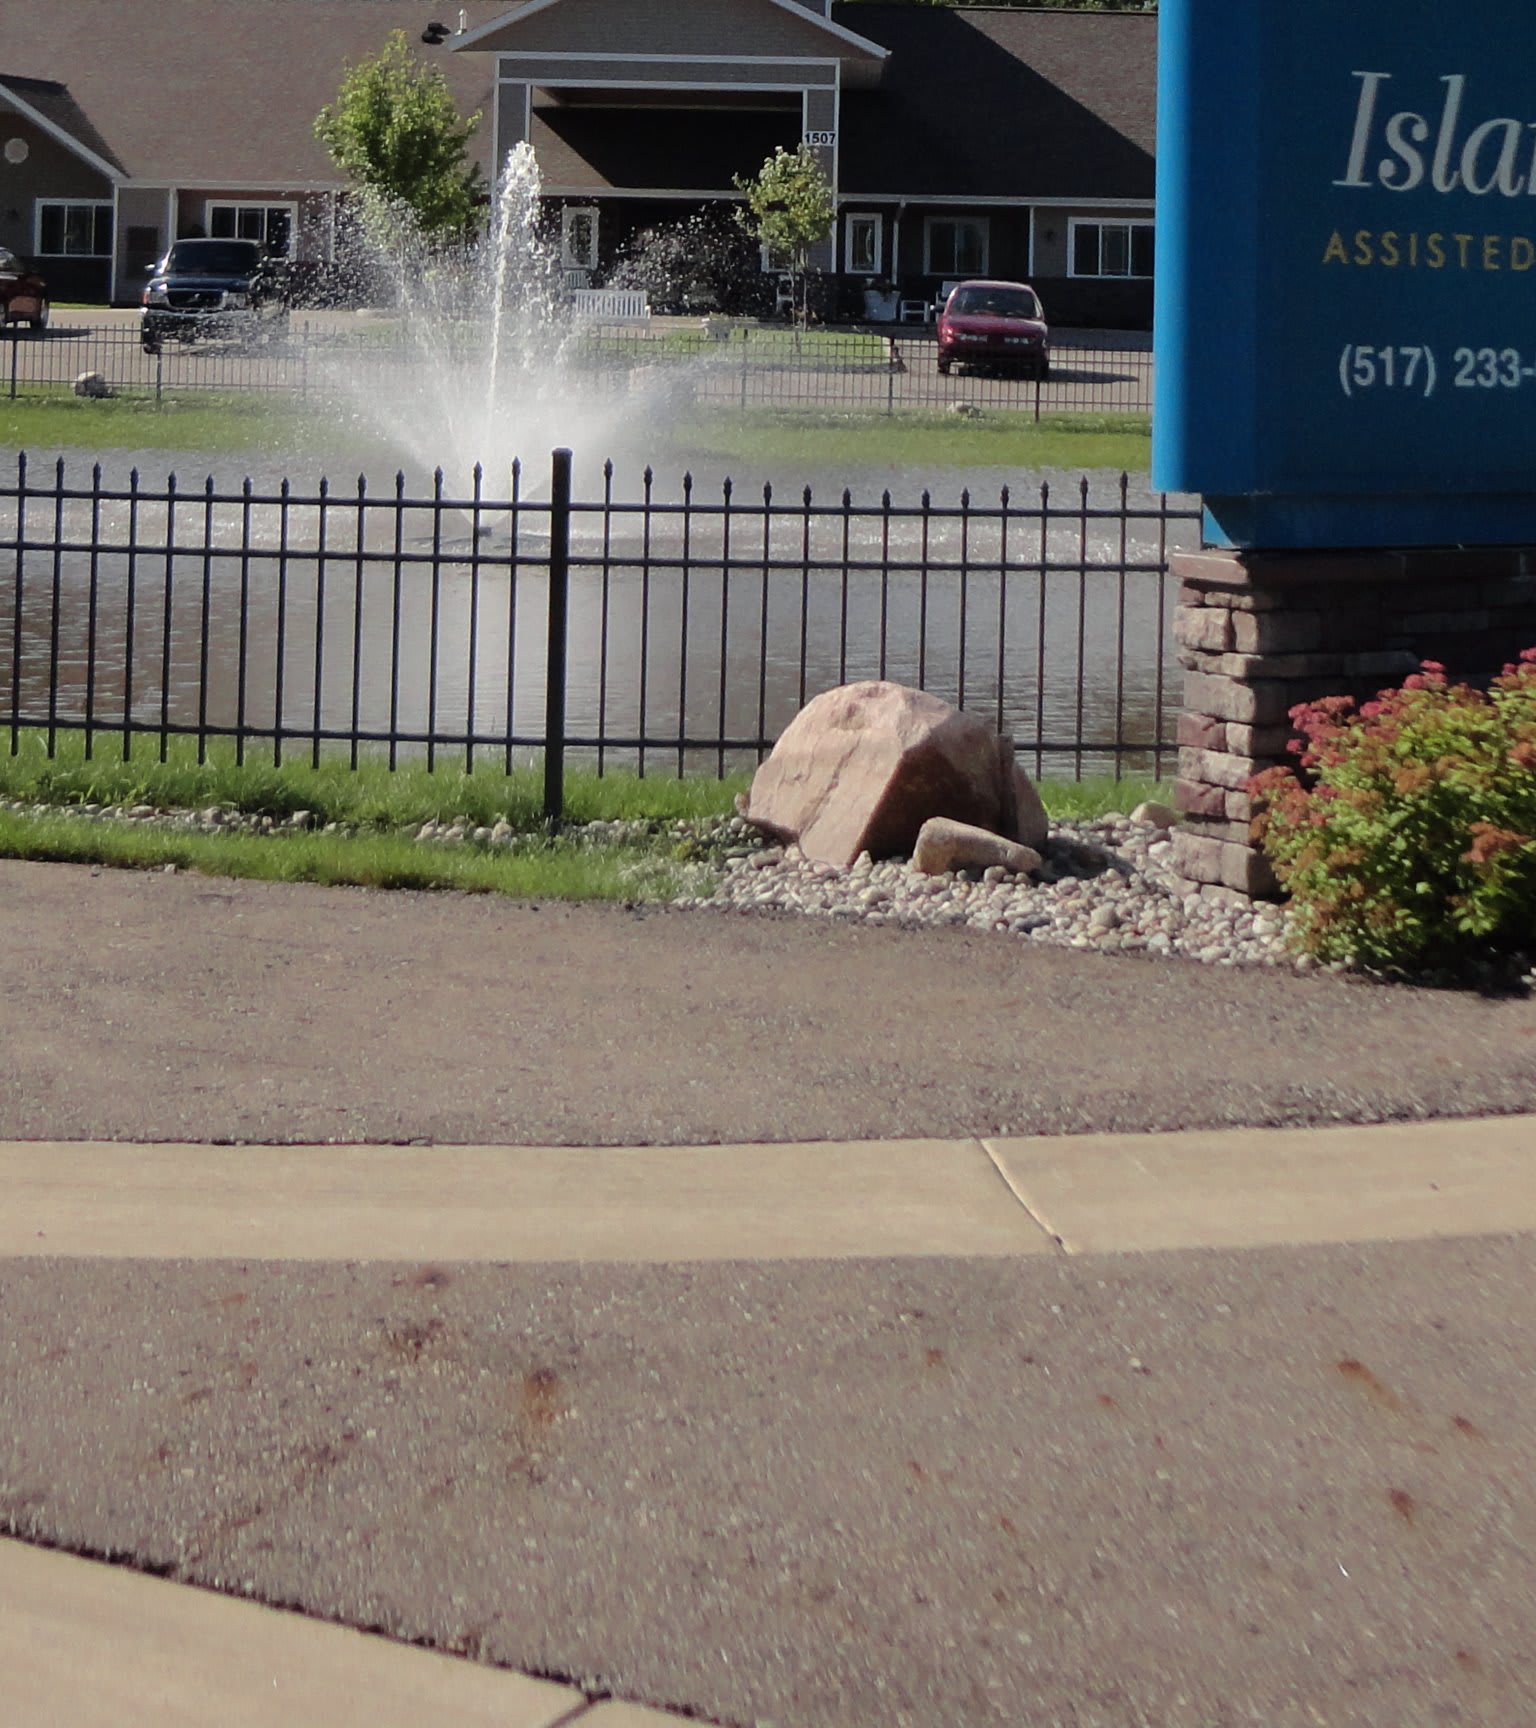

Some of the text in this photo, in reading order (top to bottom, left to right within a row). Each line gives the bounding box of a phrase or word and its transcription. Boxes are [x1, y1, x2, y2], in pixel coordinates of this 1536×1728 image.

[805, 132, 836, 145] 1507
[1322, 228, 1536, 272] ASSISTED
[1338, 344, 1436, 397] (517)
